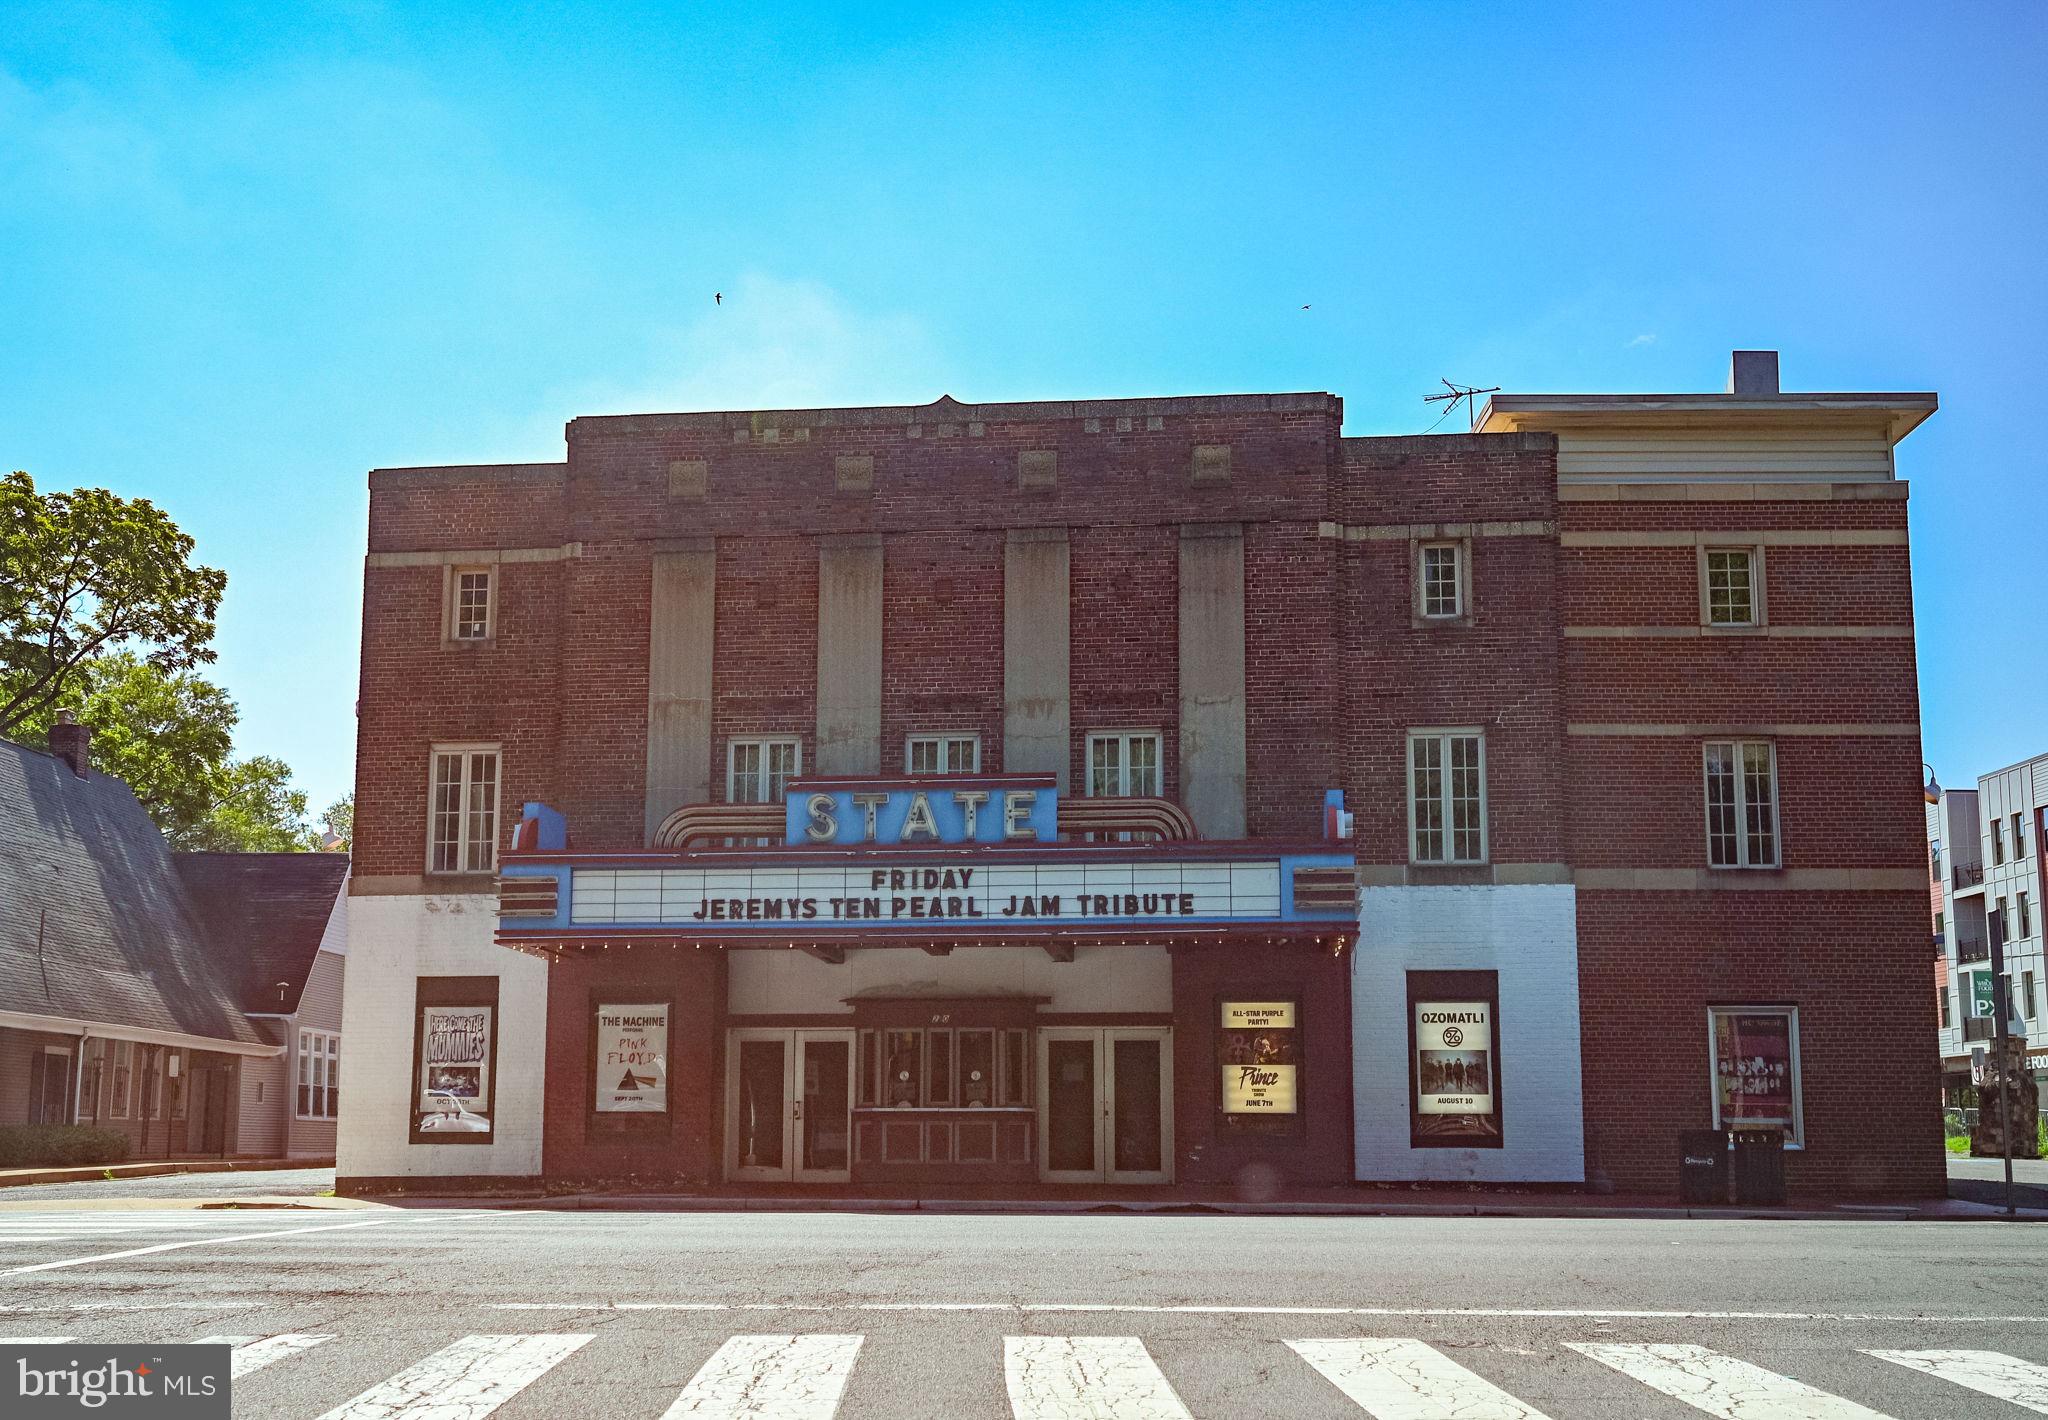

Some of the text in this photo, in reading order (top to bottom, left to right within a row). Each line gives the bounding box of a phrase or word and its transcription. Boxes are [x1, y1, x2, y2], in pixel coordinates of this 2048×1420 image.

[804, 791, 1038, 842] STATE
[871, 868, 974, 892] FRIDAY
[693, 893, 1195, 920] JEREMYS TEN PEARL JAM TRIBUTE
[430, 1015, 450, 1035] HERE
[467, 1014, 484, 1033] THE
[602, 1016, 665, 1027] THE MACHINE
[1247, 1018, 1269, 1026] PARTY!
[1421, 1012, 1484, 1024] OZOMATLI
[427, 1031, 485, 1064] MUMMIES
[619, 1037, 648, 1050] PINK
[607, 1051, 657, 1066] FLOYD
[1239, 1065, 1279, 1091] Prince
[1245, 1099, 1273, 1107] JUNE 7TH
[1437, 1097, 1474, 1105] AUGUST 10
